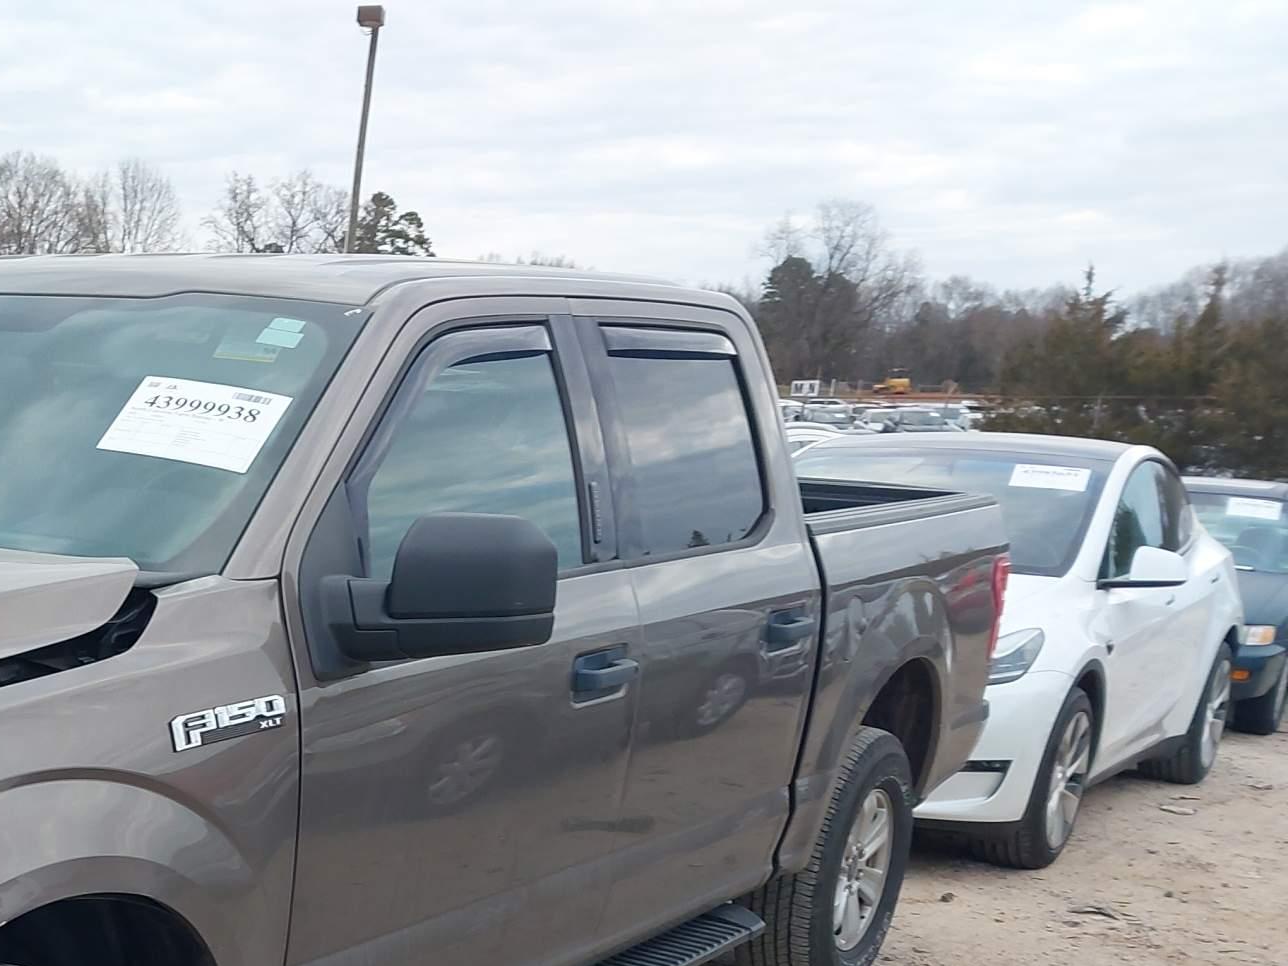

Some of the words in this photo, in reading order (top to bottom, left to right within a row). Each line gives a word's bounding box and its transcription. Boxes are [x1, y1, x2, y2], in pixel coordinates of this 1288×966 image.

[144, 394, 261, 423] 43999938
[169, 694, 286, 752] F150
[259, 717, 282, 729] XLT
